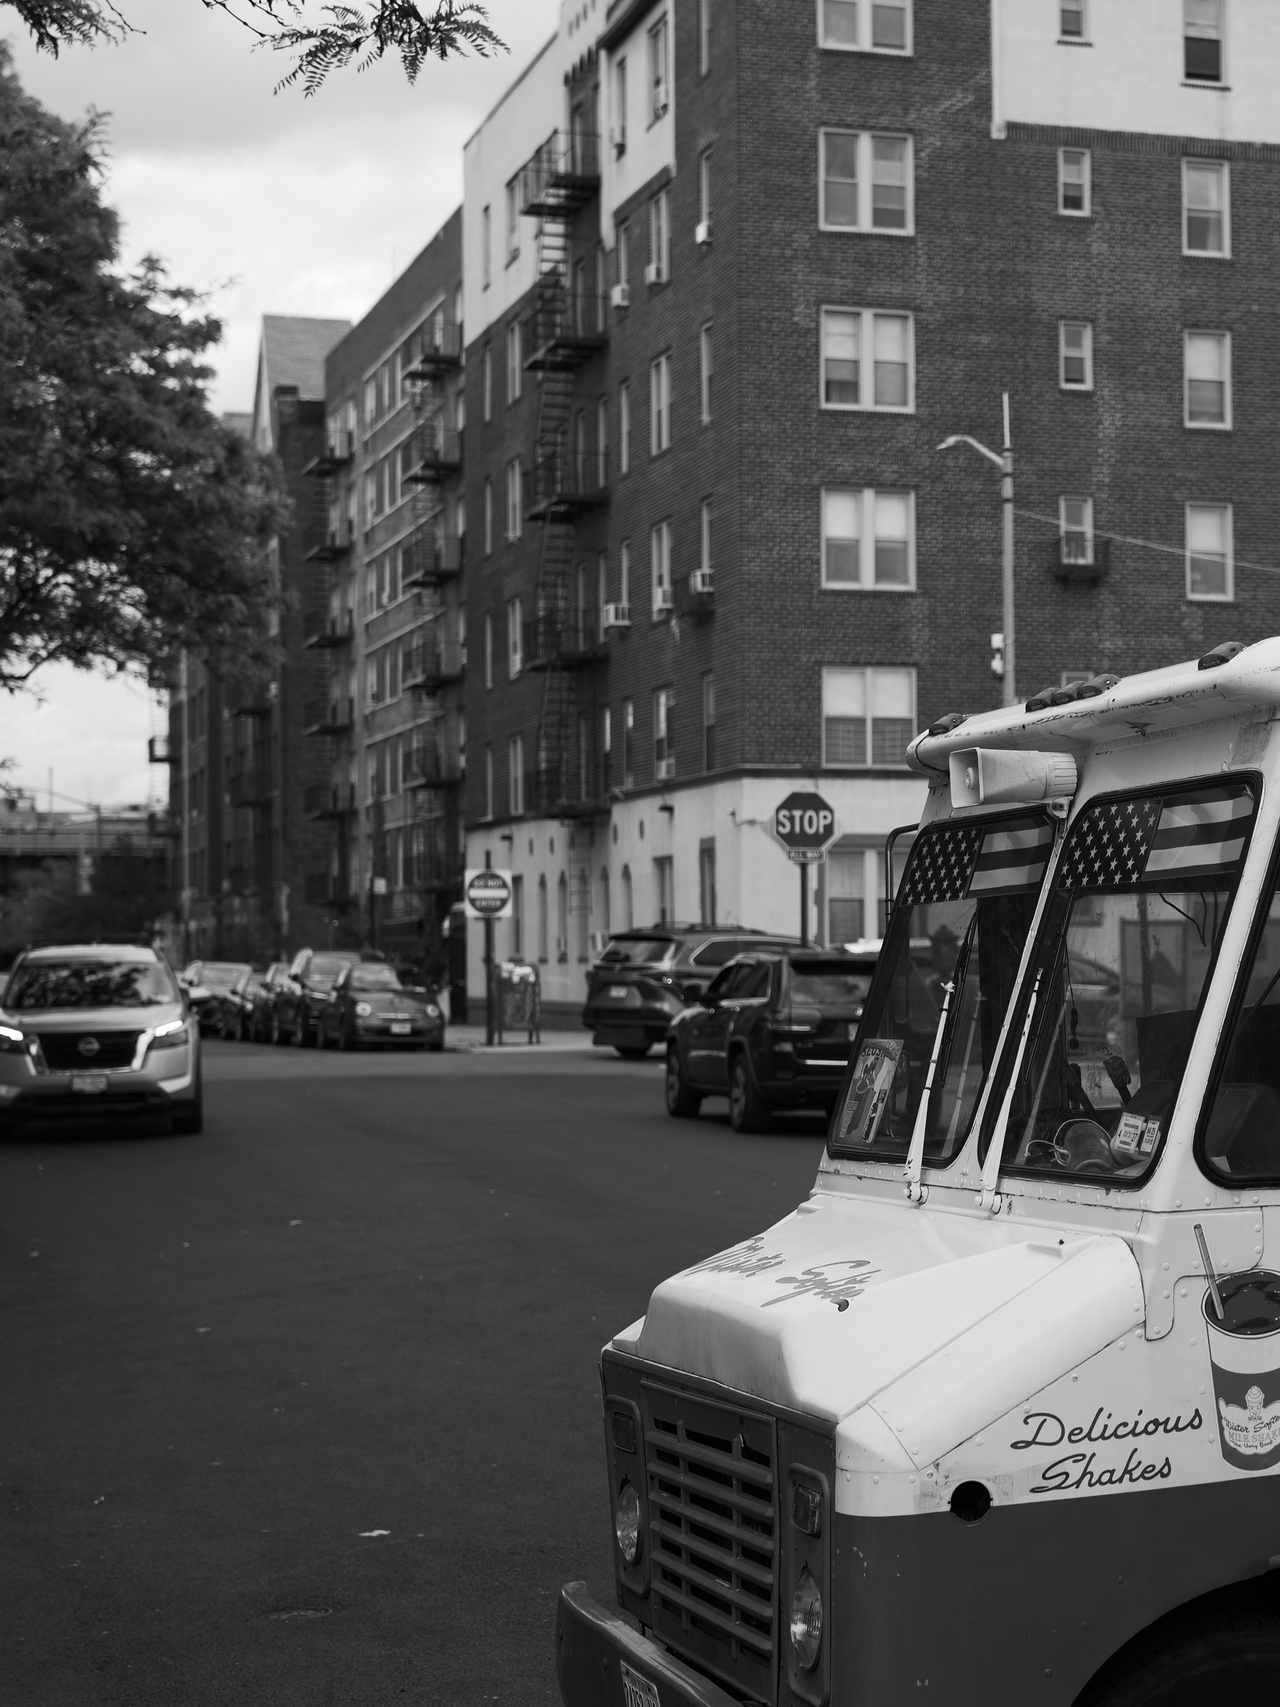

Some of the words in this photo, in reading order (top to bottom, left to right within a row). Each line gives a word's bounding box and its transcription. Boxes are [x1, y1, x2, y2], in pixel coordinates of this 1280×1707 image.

[778, 809, 832, 834] STOP
[473, 878, 485, 887] DO
[488, 878, 502, 887] NOT
[1010, 1406, 1203, 1450] Delicious
[1223, 1416, 1250, 1433] Mister
[1228, 1430, 1250, 1443] MILK
[1029, 1448, 1172, 1493] Shakes
